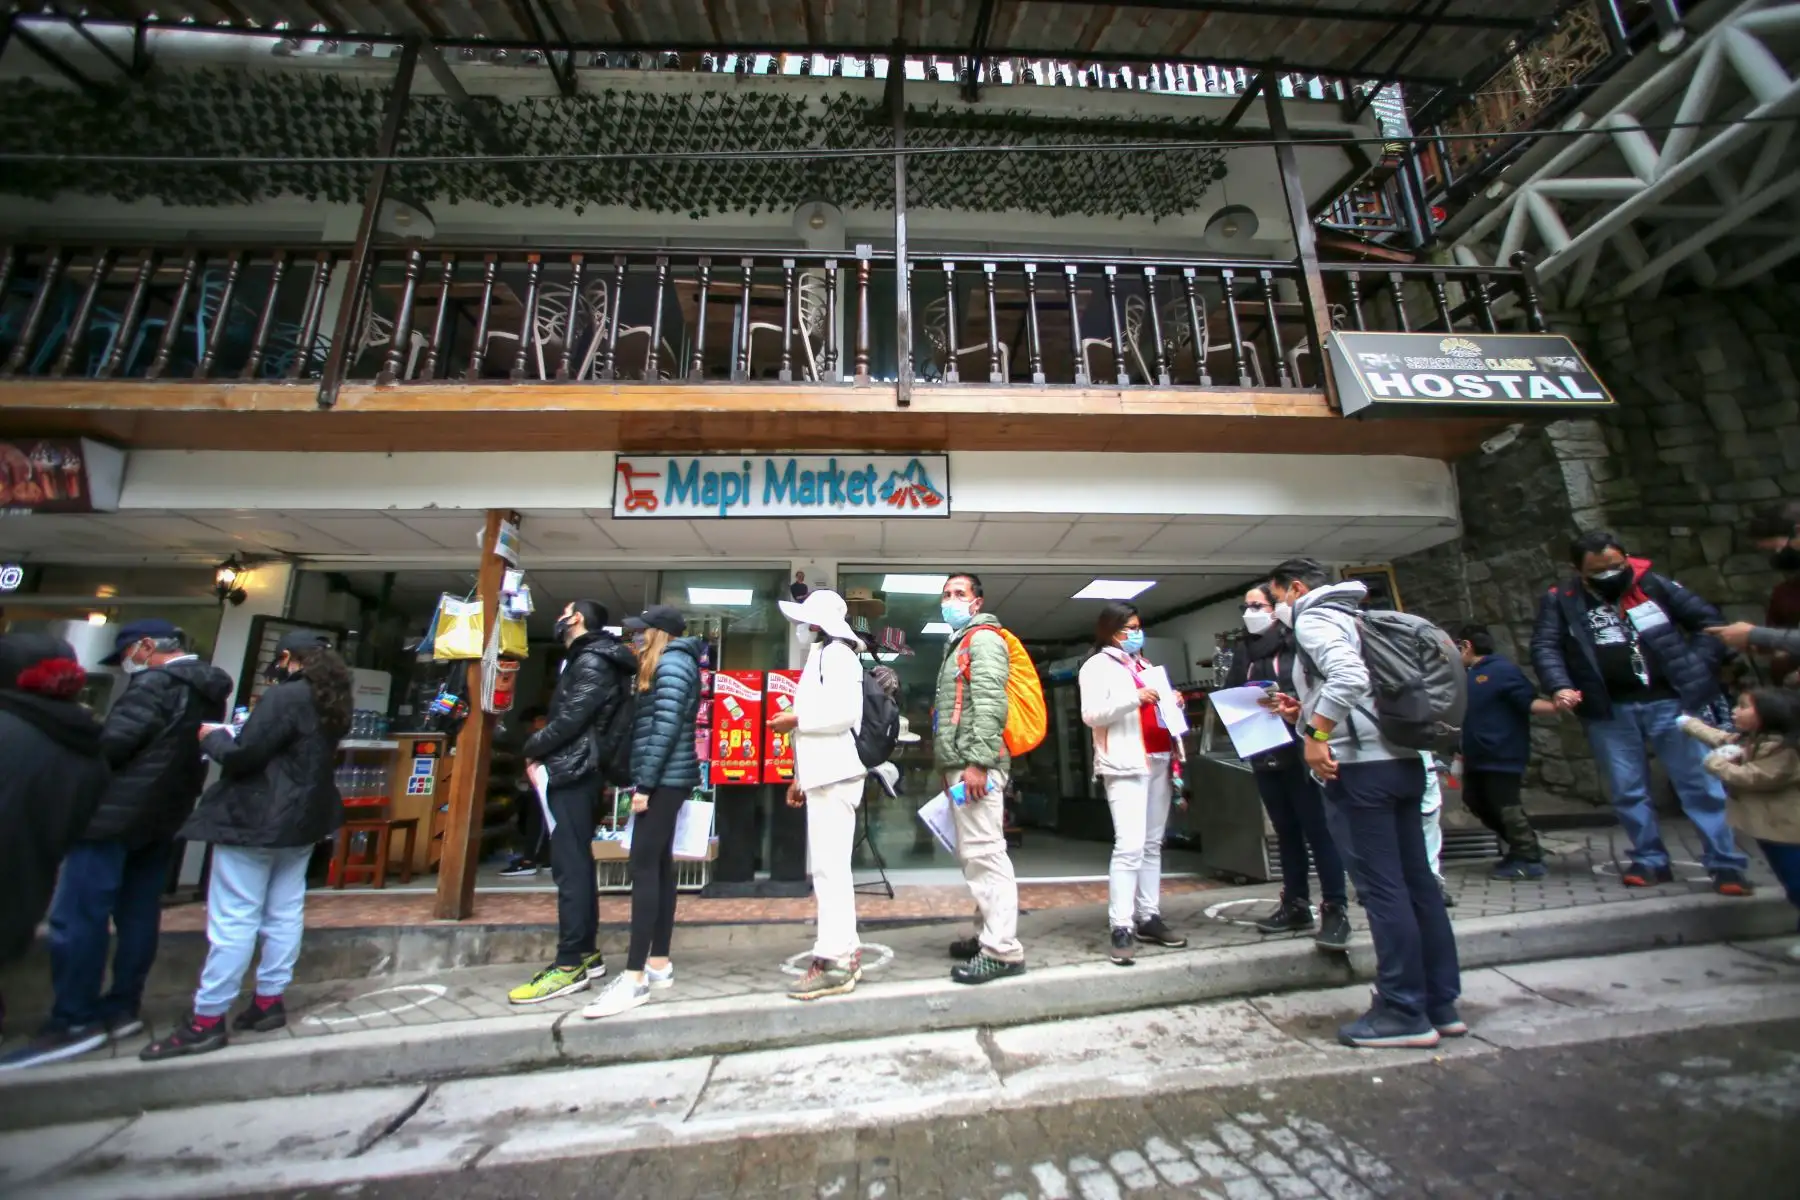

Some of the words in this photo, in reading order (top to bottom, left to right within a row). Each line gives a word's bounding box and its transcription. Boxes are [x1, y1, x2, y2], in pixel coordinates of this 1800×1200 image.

[1366, 373, 1604, 399] HOSTAL
[664, 459, 752, 518] Mapi
[763, 458, 878, 507] Market
